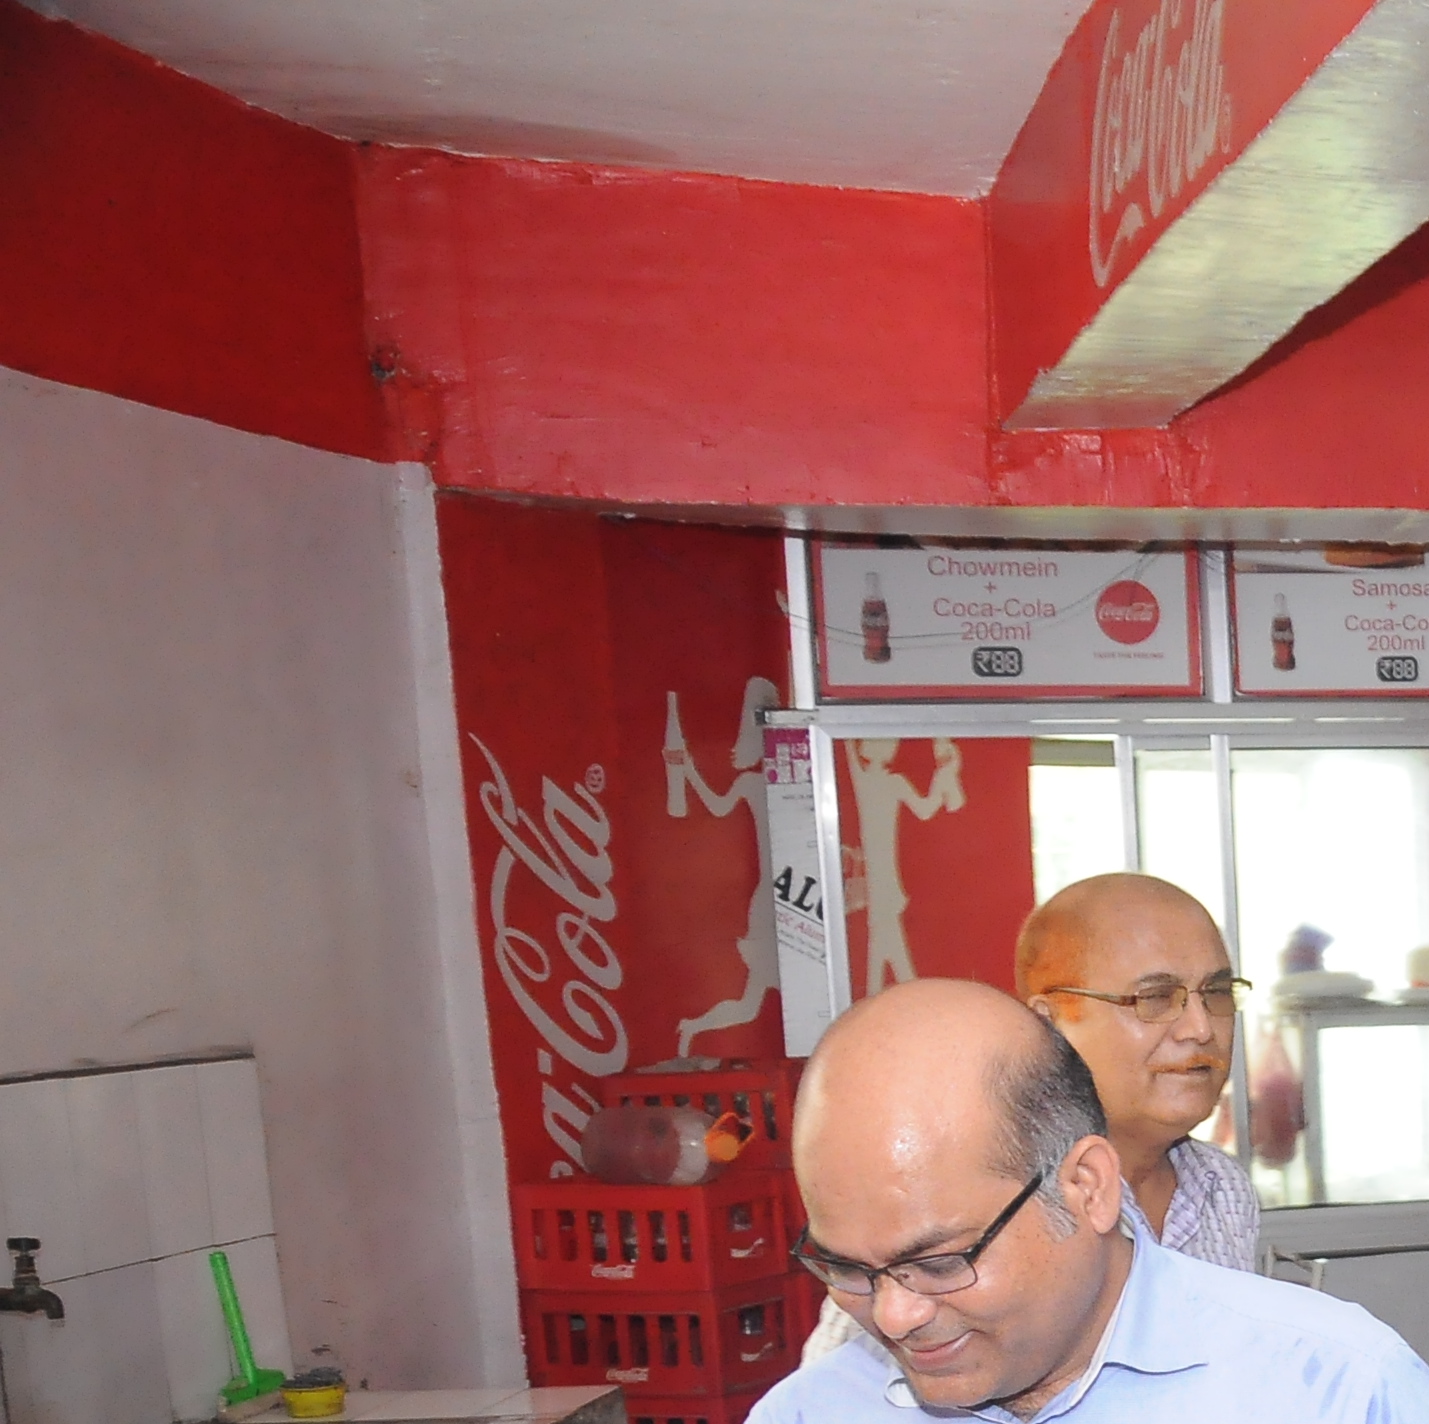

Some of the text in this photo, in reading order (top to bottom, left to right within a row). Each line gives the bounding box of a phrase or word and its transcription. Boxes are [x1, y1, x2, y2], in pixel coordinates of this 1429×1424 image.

[928, 555, 1058, 578] Chowmein
[933, 598, 1056, 618] Coca-Cola
[961, 621, 1031, 642] 200ml
[1367, 634, 1426, 651] 200ml
